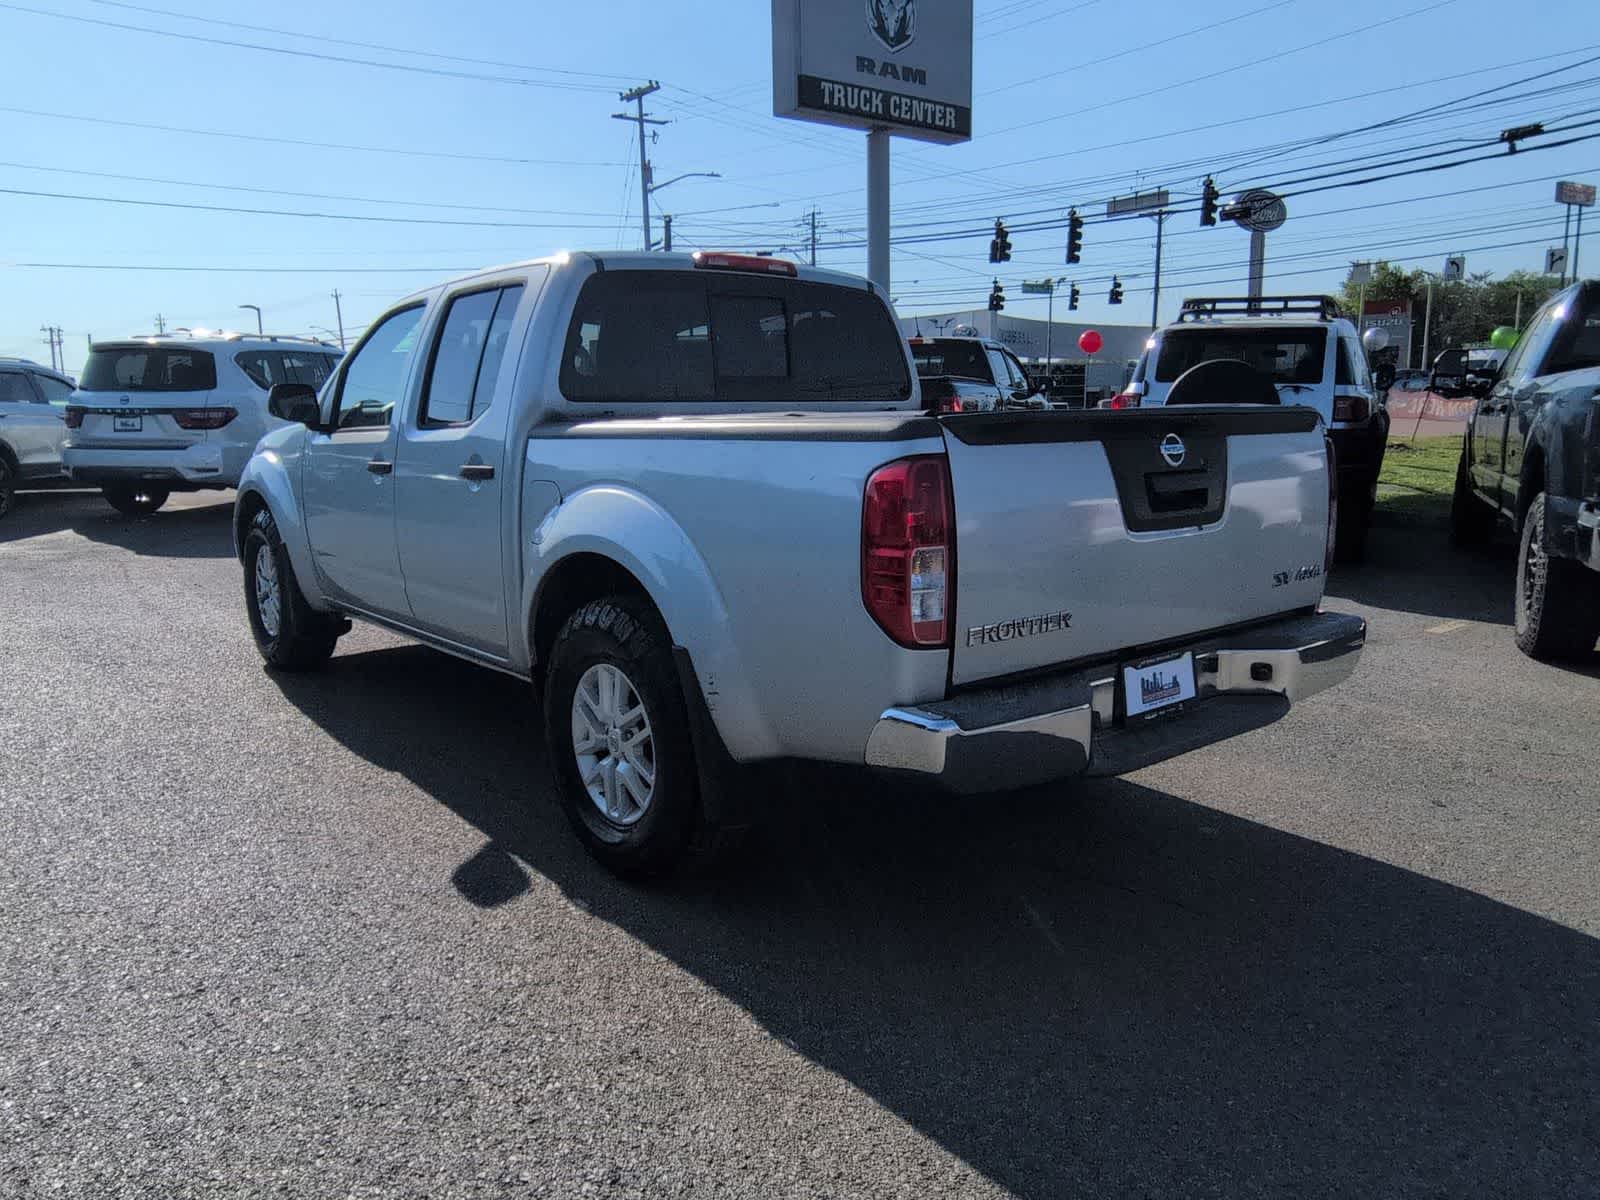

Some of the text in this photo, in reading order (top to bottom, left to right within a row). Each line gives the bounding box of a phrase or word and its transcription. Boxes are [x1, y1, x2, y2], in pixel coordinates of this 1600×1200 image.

[856, 55, 927, 85] RAM
[820, 81, 956, 129] TRUCK CENTER
[966, 610, 1073, 648] FRONTIER
